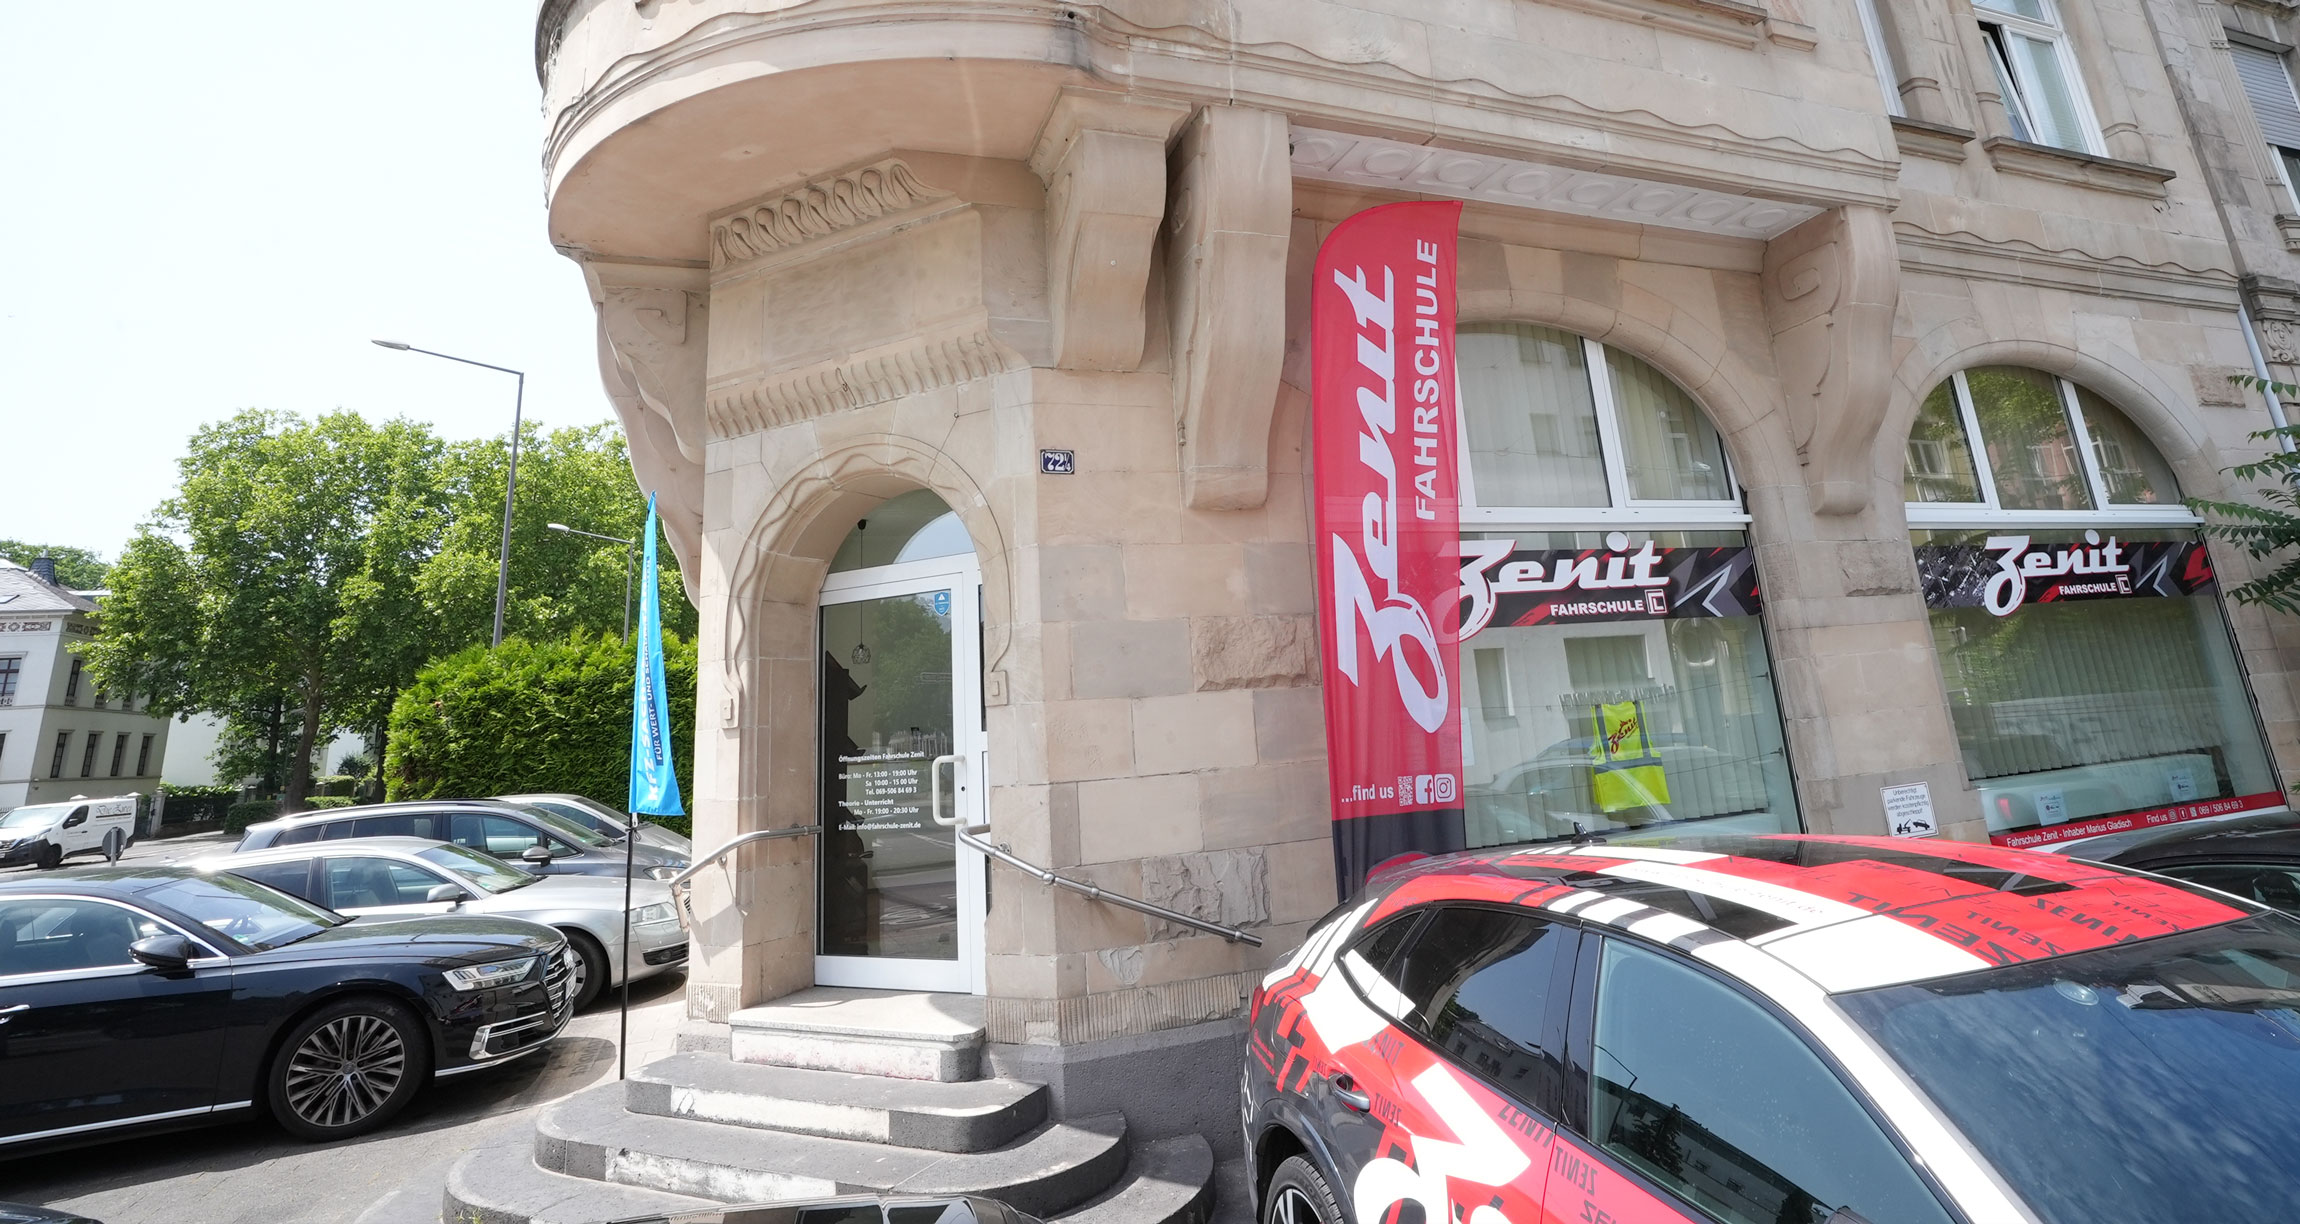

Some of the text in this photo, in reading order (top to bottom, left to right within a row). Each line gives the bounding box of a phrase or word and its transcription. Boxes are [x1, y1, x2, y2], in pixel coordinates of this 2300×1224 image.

[1413, 238, 1440, 520] FAHRSCHULE
[1333, 264, 1449, 733] Zenit
[1983, 529, 2131, 617] Zenit
[1440, 531, 1670, 644] Zenit
[2059, 582, 2117, 596] FAHRSCHULE
[1550, 599, 1645, 616] FAHRSCHULE
[648, 703, 660, 738] WERT-
[1607, 717, 1638, 754] Zenit
[653, 741, 663, 760] FÜR
[838, 754, 882, 763] Öffnungszeiten
[882, 752, 910, 760] Fahrschule
[1379, 786, 1394, 800] us
[2146, 814, 2160, 824] Find
[2198, 805, 2209, 815] 069
[2224, 802, 2231, 810] 84
[2006, 833, 2042, 847] Fahrschule
[2042, 831, 2059, 841] Zenit
[2062, 827, 2086, 838] Inhaber
[2086, 823, 2107, 834] Marius
[2106, 818, 2133, 830] Gladisch
